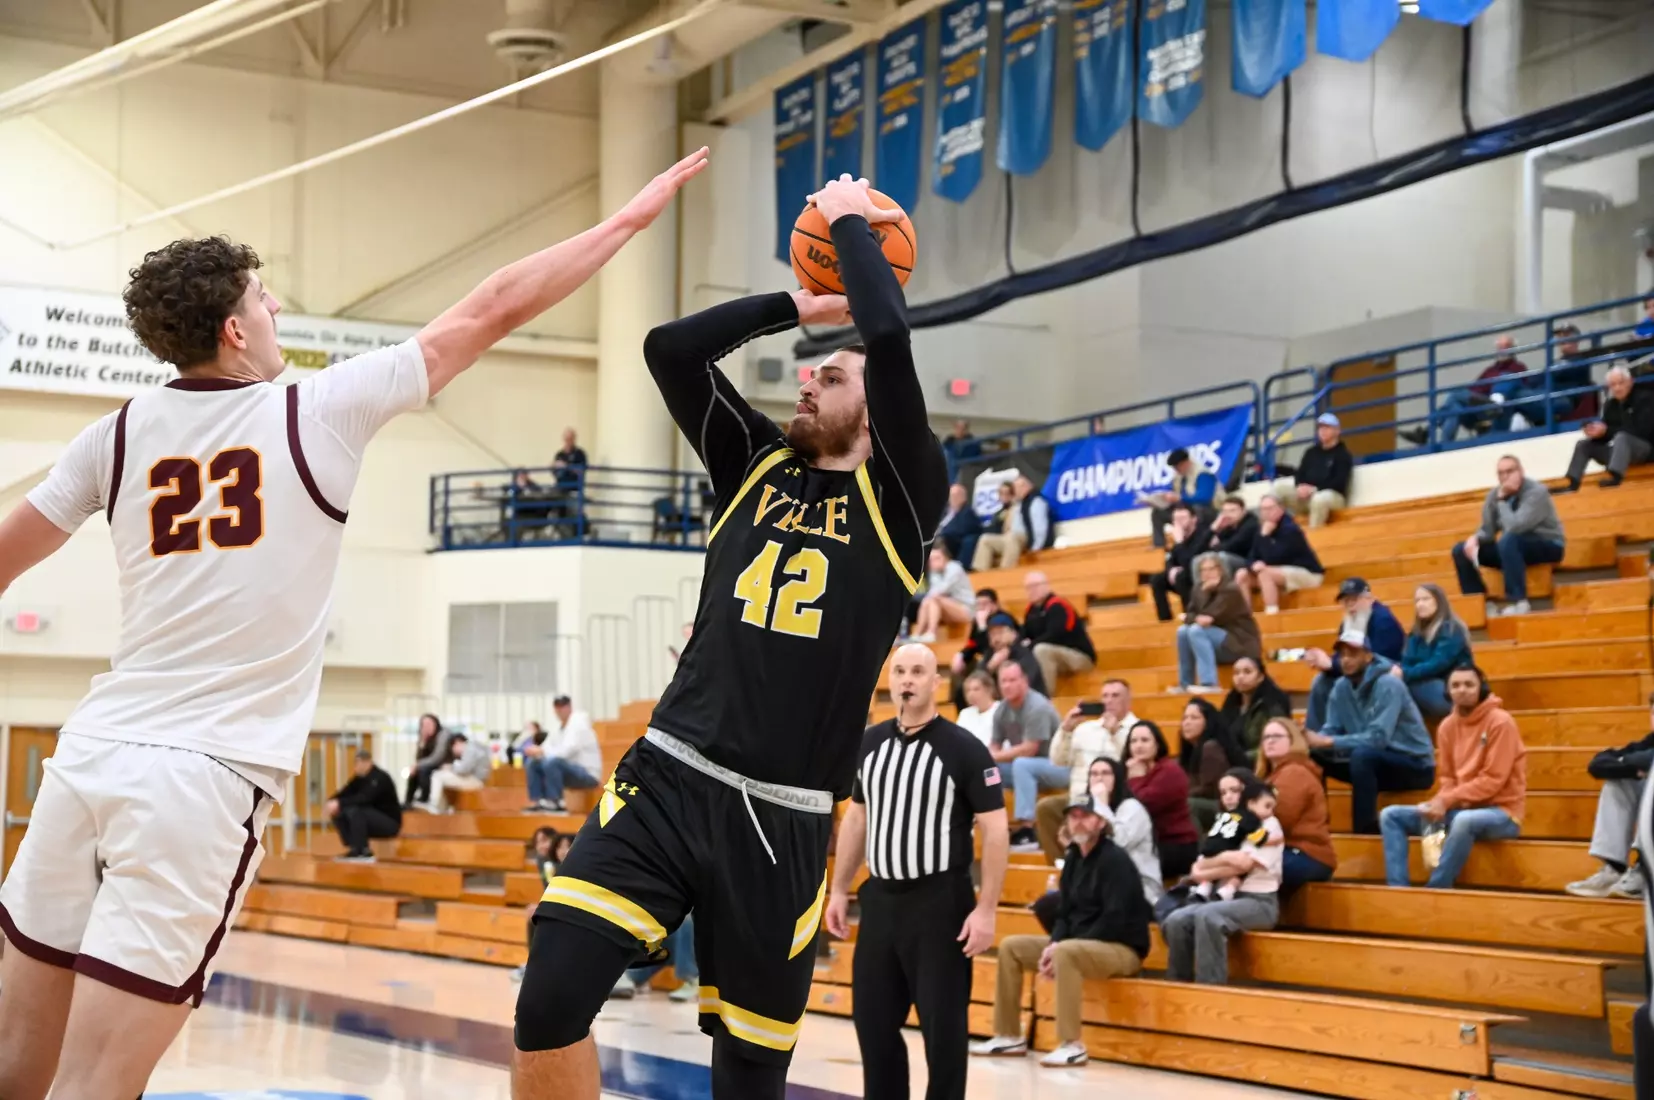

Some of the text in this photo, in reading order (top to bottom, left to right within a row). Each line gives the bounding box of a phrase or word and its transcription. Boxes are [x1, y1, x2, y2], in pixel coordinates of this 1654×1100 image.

[9, 357, 90, 379] Athletic
[18, 333, 38, 347] to
[47, 334, 79, 351] the
[147, 444, 265, 558] 23
[1056, 439, 1222, 504] CHAMPIONSIPS
[733, 539, 830, 639] 42
